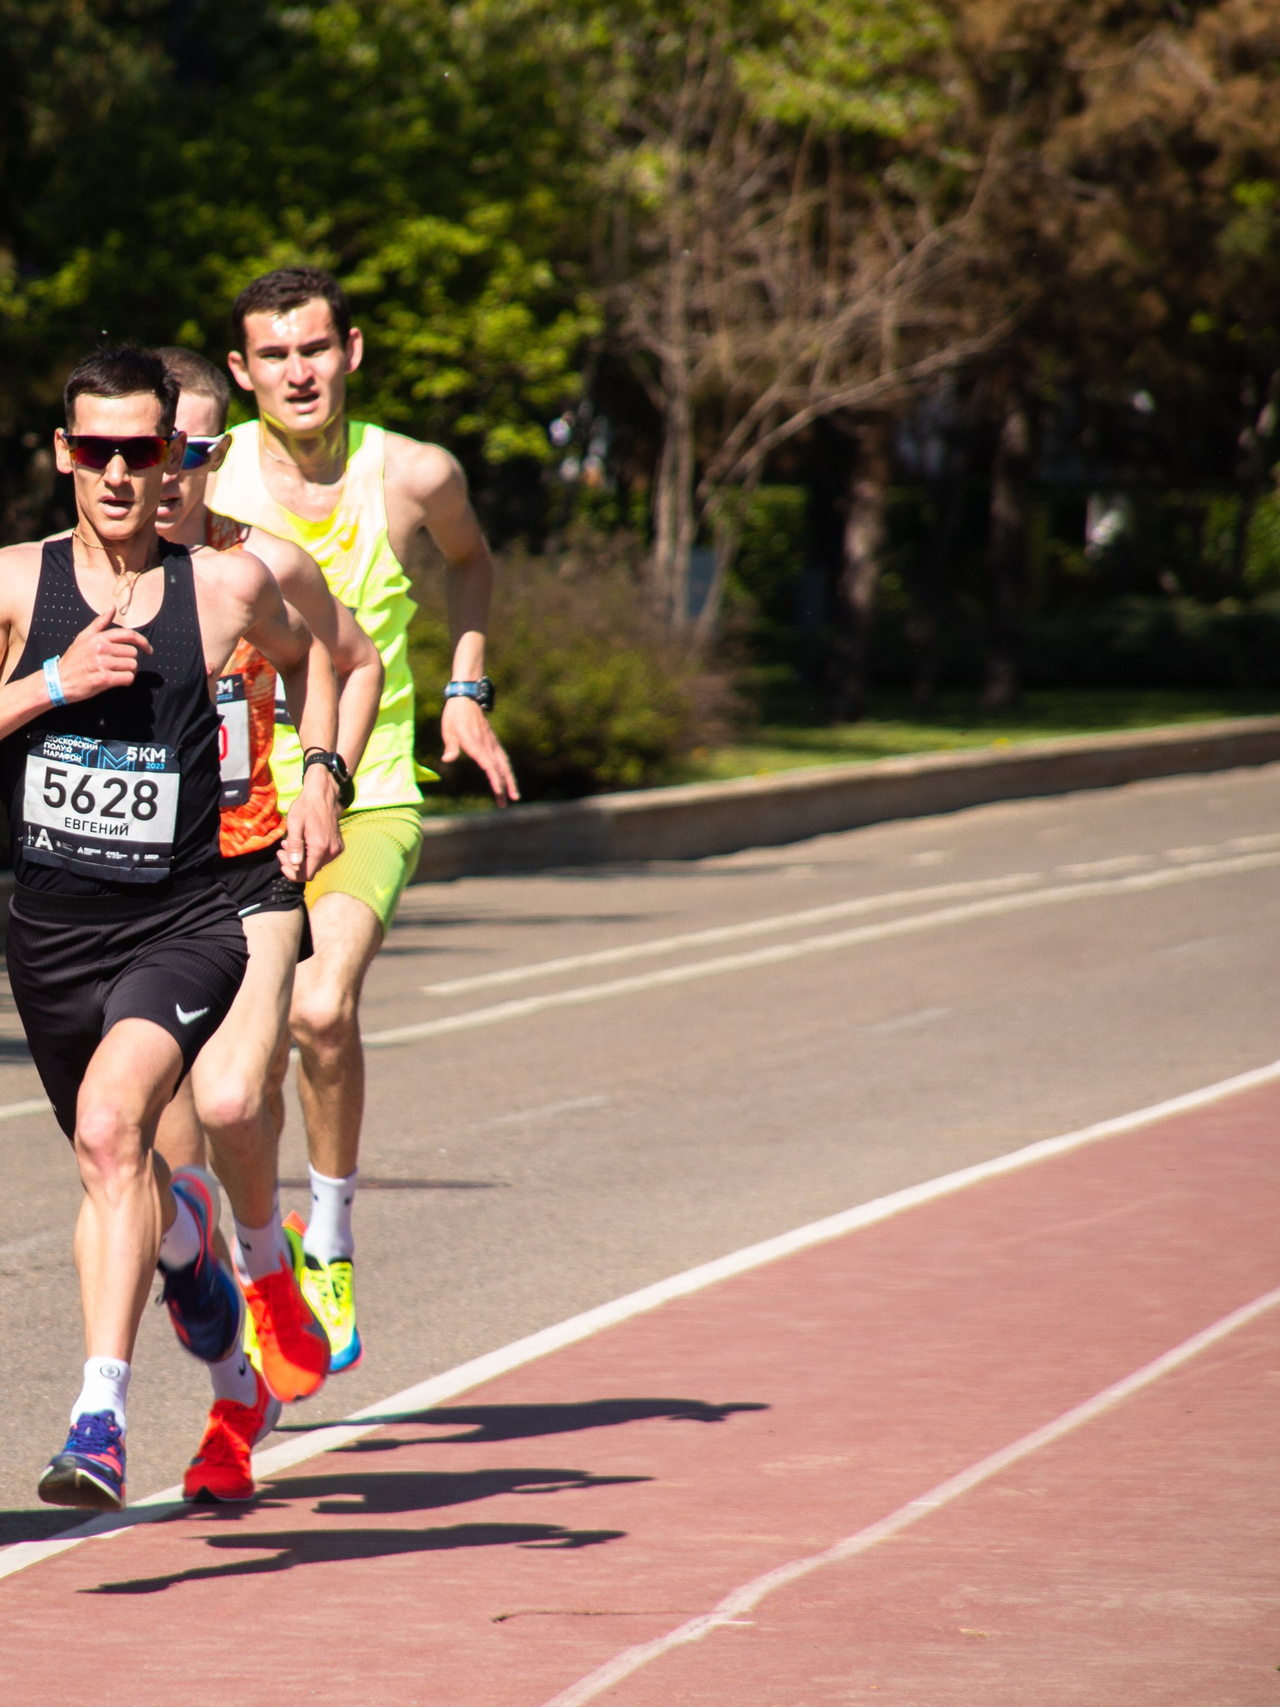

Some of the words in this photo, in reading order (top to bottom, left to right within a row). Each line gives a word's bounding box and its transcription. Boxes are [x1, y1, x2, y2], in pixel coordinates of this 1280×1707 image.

[45, 734, 99, 750] МОСКОВСКИЙ
[42, 749, 82, 762] МАРАФОН
[145, 762, 165, 770] 2023
[42, 766, 159, 821] 5628
[64, 816, 130, 836] ЕВГЕНИЙ
